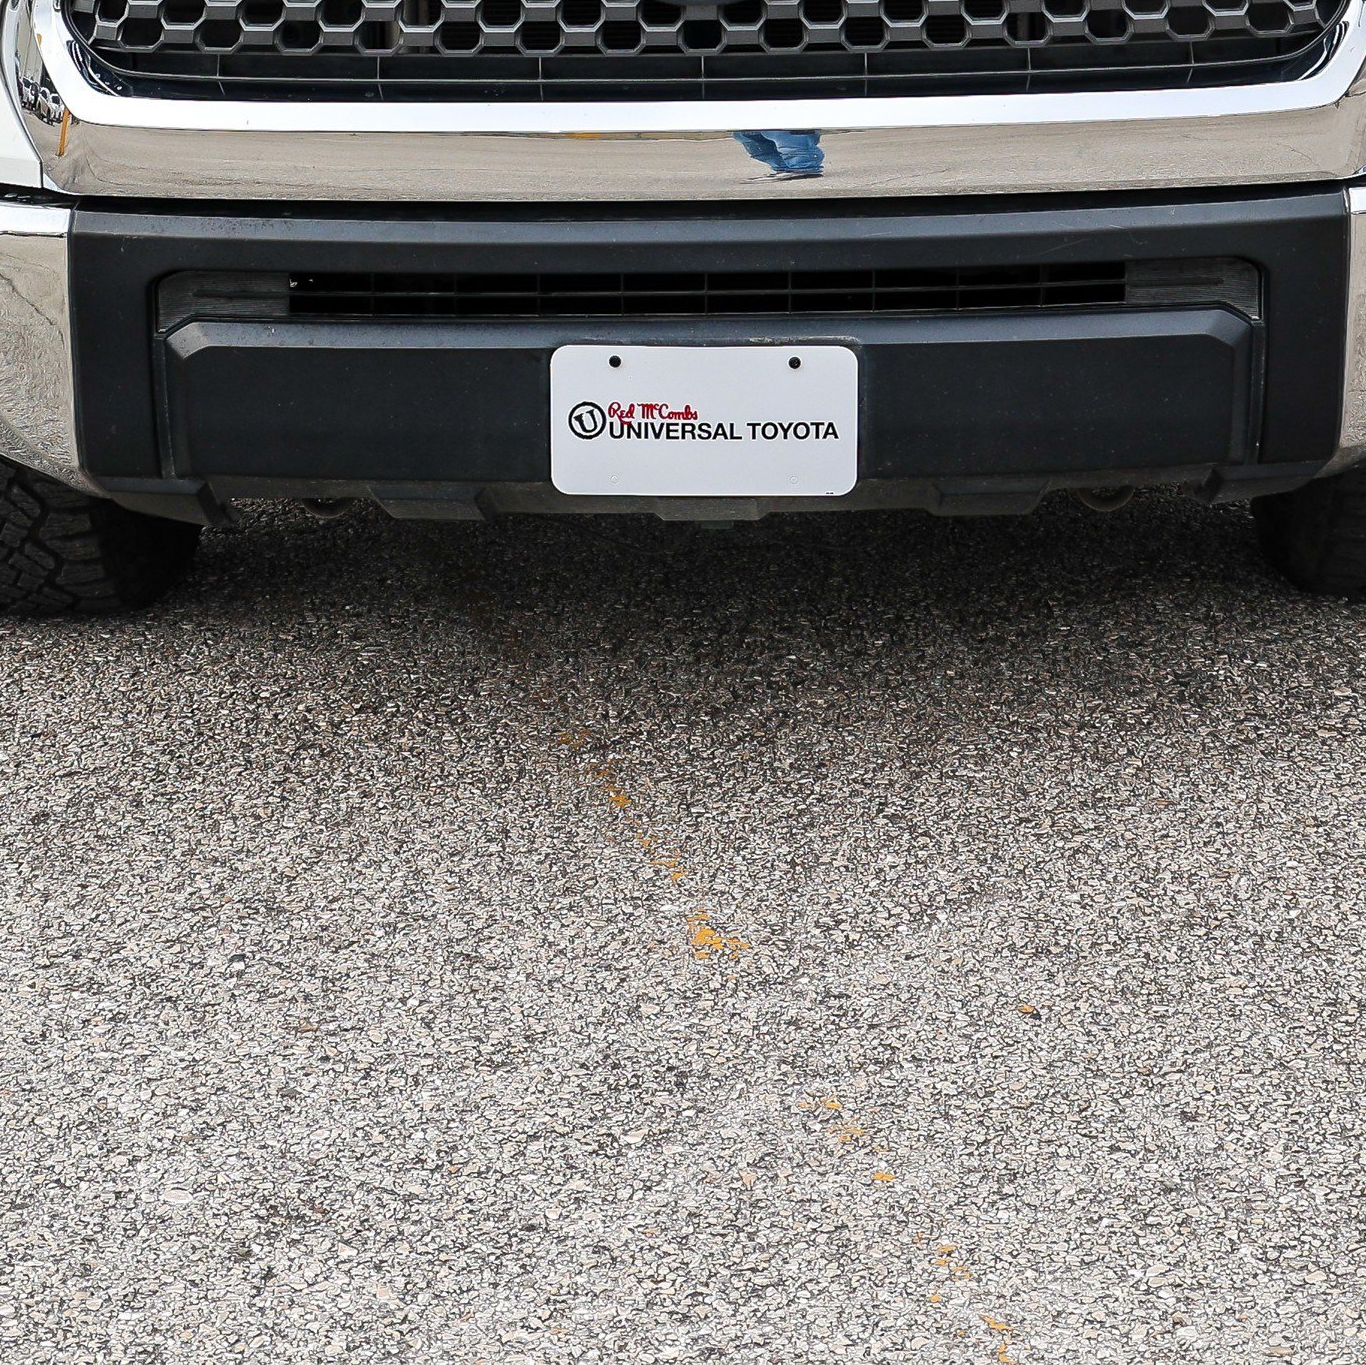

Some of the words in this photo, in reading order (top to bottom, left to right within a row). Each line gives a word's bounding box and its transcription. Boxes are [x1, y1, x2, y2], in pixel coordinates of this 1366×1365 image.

[608, 401, 635, 426] Red
[637, 402, 698, 421] McCombs
[609, 422, 742, 440] UNIVERSAL
[747, 421, 839, 440] TOYOTA
